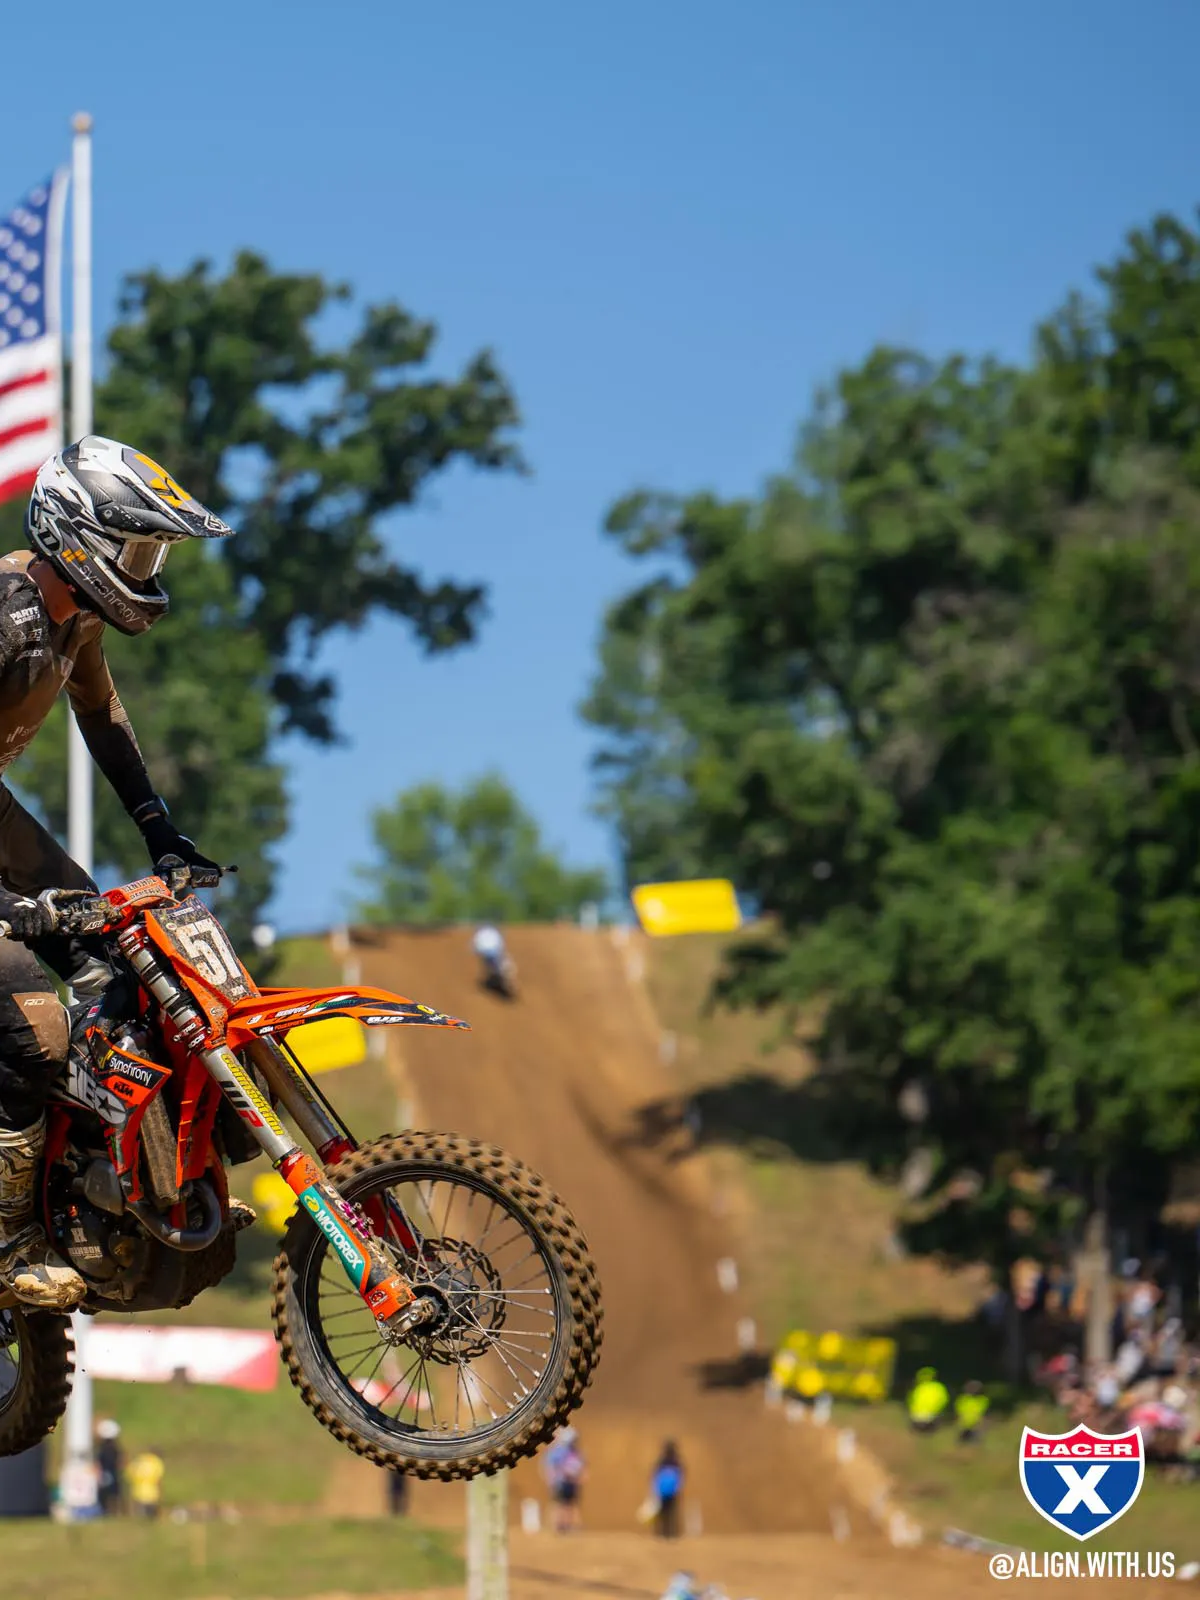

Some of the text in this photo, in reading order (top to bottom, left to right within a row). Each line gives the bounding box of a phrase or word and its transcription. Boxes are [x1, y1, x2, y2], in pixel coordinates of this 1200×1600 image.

[176, 917, 242, 986] 57
[109, 1053, 154, 1088] synchrony
[113, 1081, 135, 1098] KTM
[315, 1209, 363, 1270] MOTOREX
